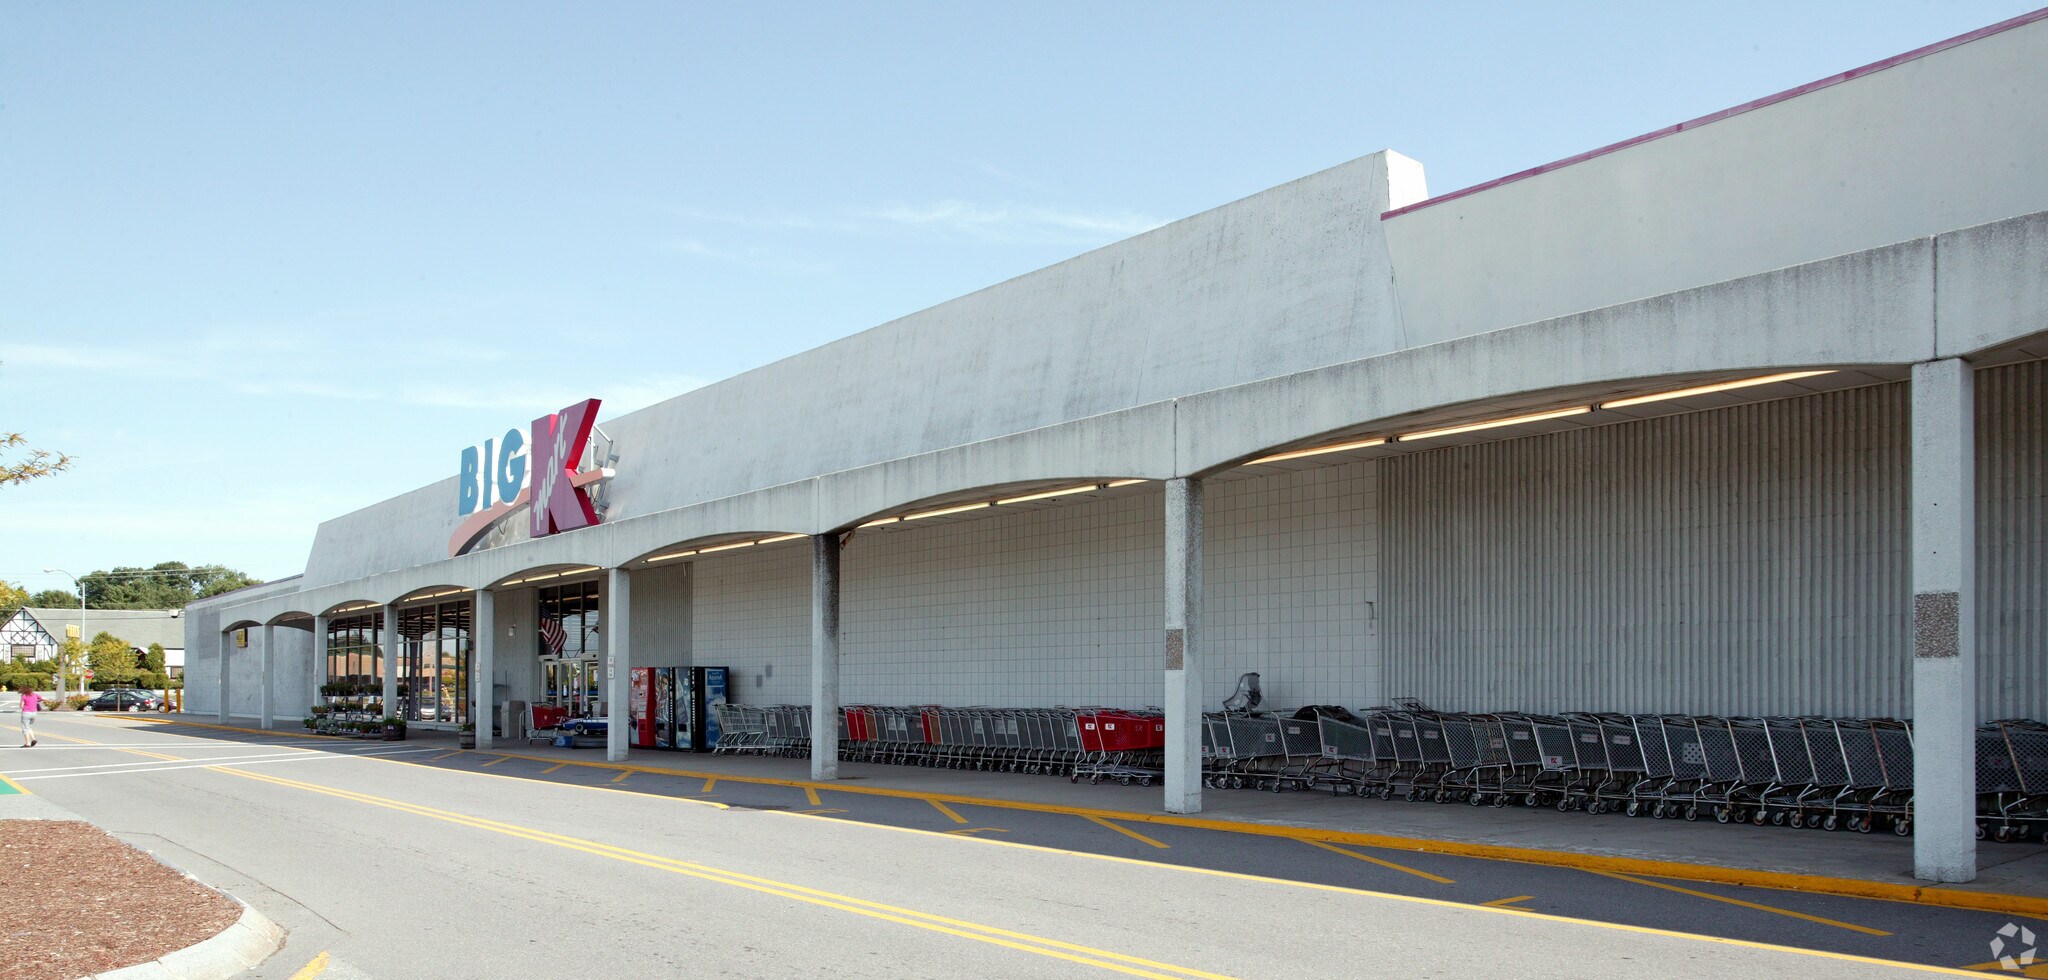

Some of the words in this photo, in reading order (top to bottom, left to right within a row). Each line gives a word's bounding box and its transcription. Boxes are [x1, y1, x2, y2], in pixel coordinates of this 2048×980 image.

[459, 428, 527, 517] BIG
[530, 398, 602, 538] K
[533, 412, 568, 531] mart
